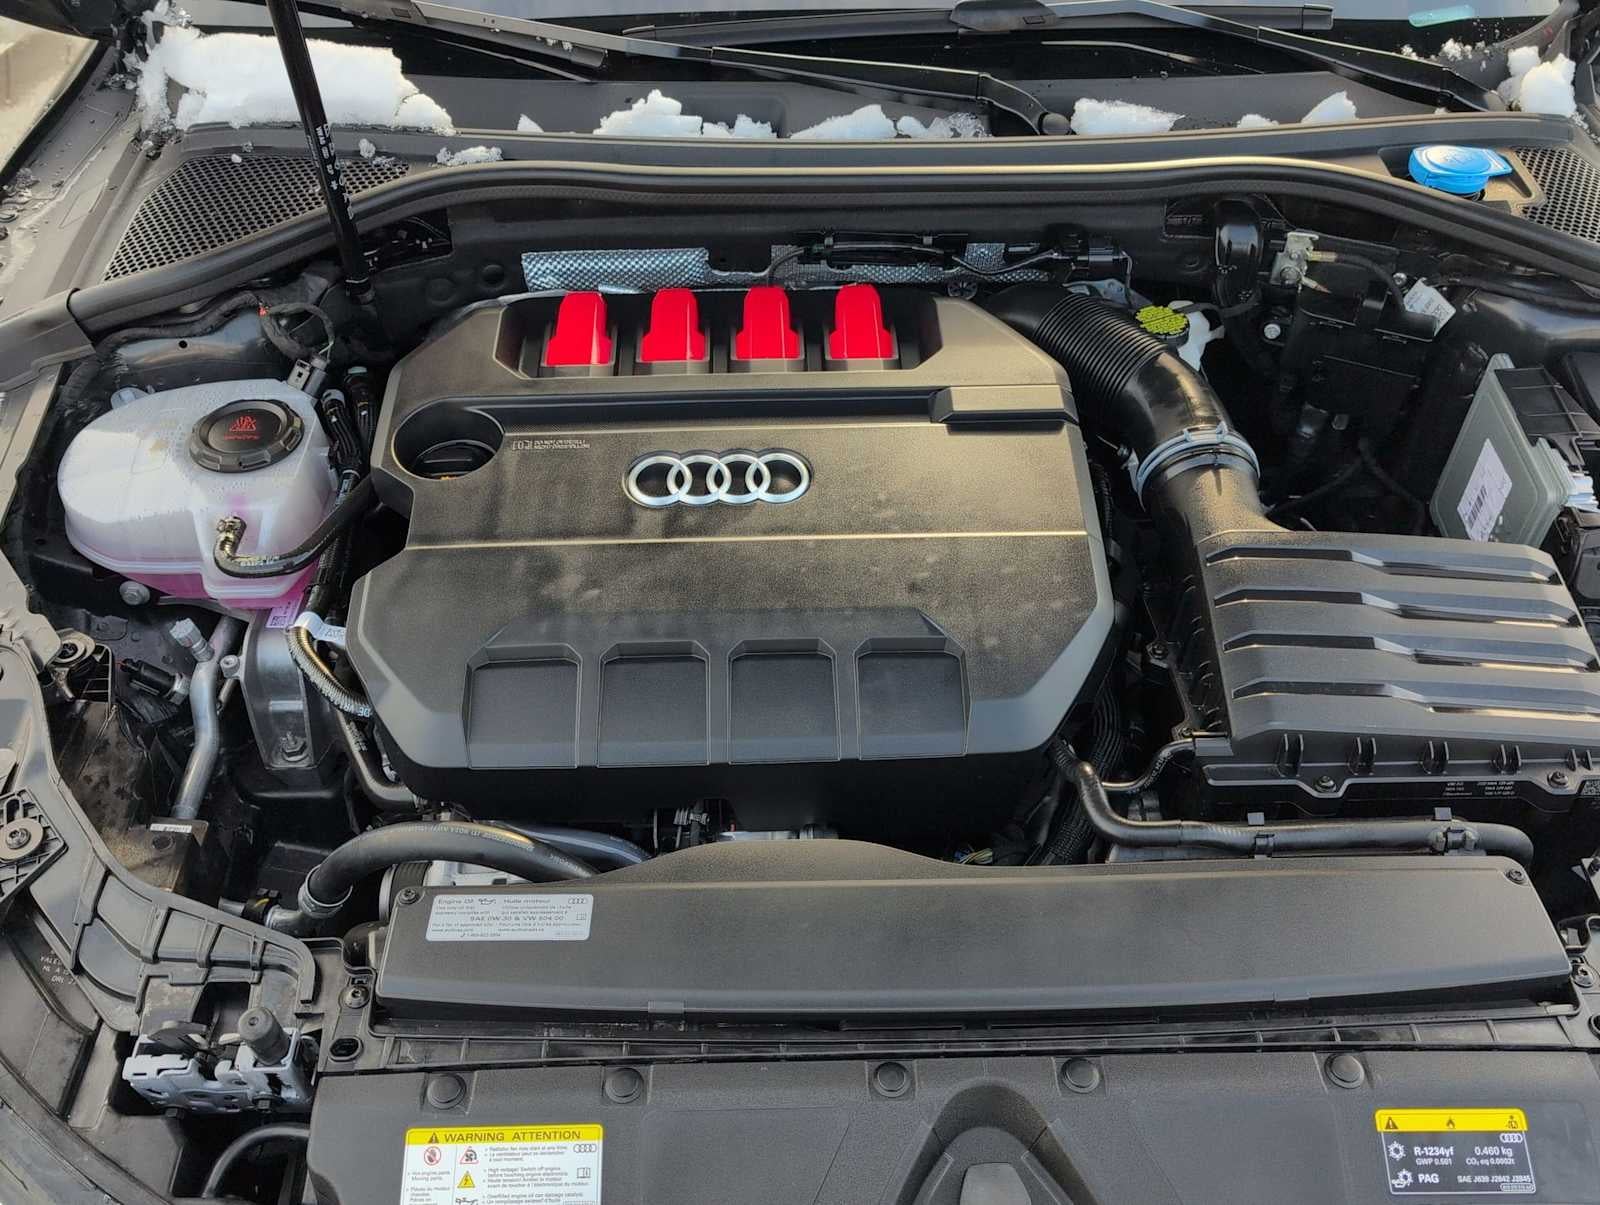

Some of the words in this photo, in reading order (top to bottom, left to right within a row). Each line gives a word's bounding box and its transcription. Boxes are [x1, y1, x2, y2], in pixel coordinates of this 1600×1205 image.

[444, 1132, 505, 1143] WARNING
[512, 1130, 581, 1142] ATTENTION
[1413, 1146, 1454, 1157] R-1234yf
[1474, 1146, 1500, 1156] 0.460
[1501, 1146, 1513, 1157] kg
[1418, 1173, 1440, 1183] PAG
